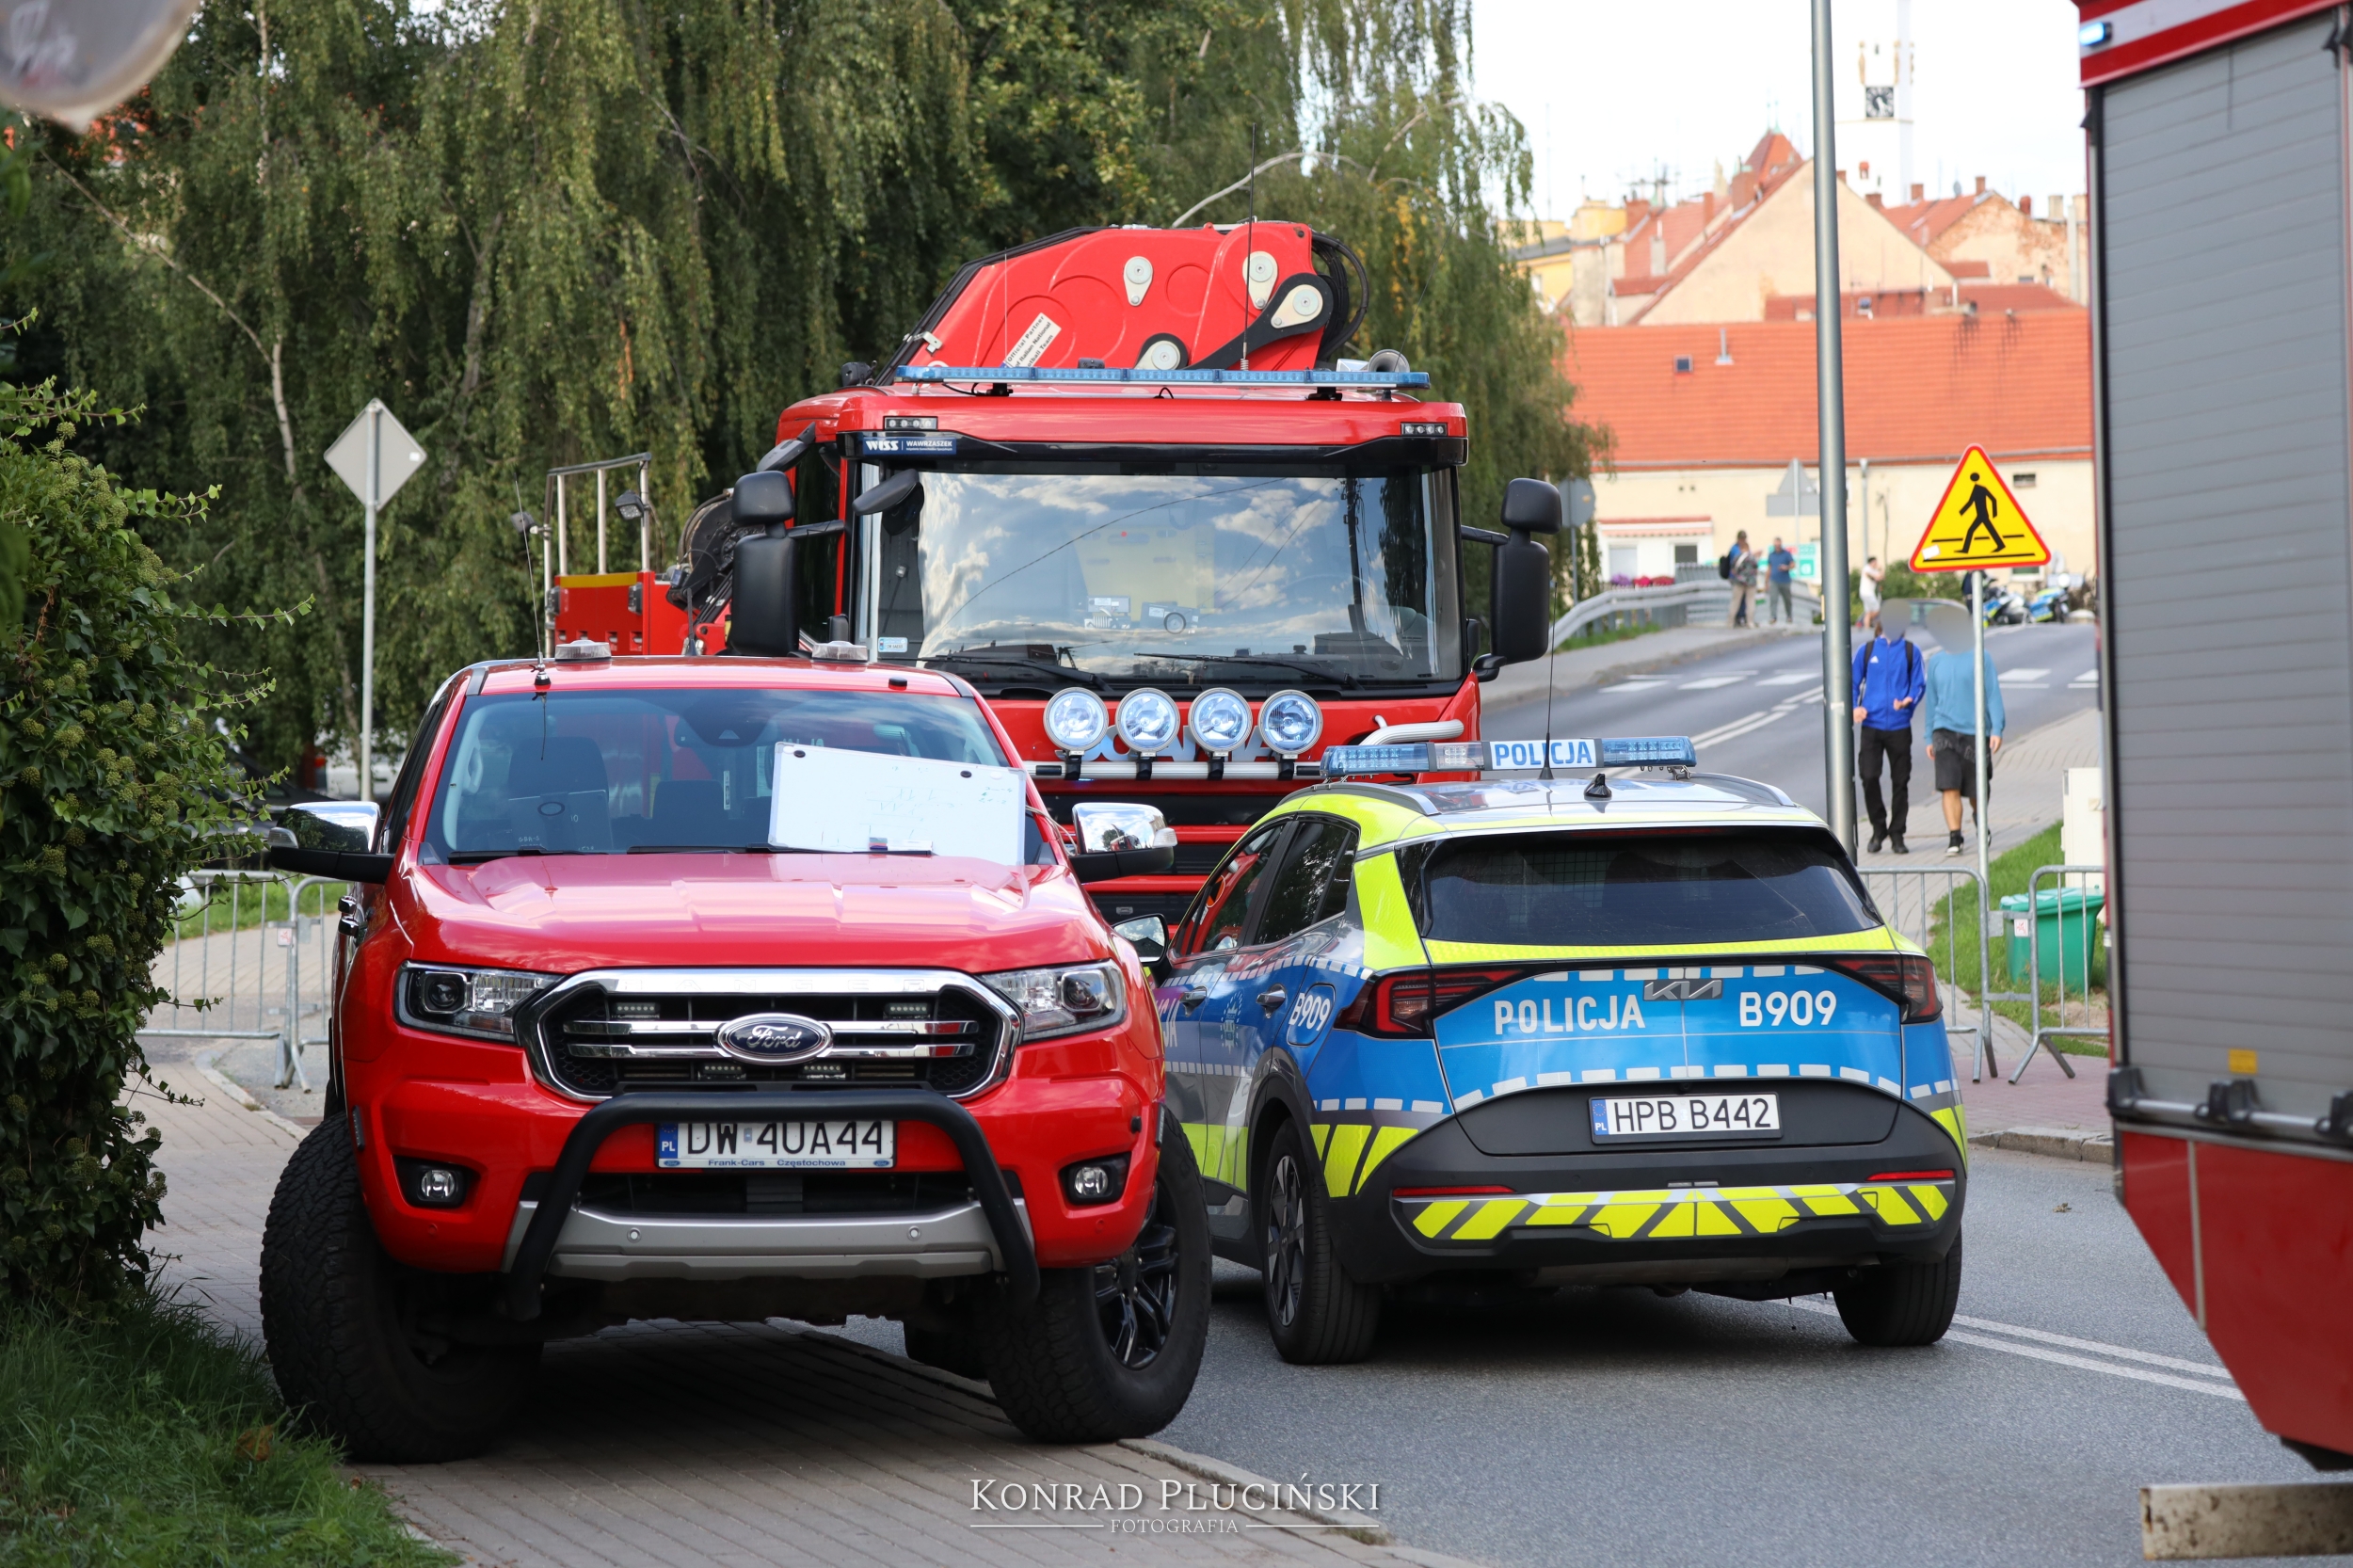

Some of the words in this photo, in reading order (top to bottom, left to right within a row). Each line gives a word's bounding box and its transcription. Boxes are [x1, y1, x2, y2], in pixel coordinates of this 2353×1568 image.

[1007, 339, 1026, 362] Official
[1025, 315, 1045, 340] Partner
[1019, 344, 1033, 361] Italian
[1032, 321, 1051, 344] National
[1027, 350, 1041, 367] otball
[1039, 334, 1053, 349] Team
[865, 440, 899, 451] WISS
[1494, 741, 1593, 766] POLICJA
[620, 979, 925, 991] RANGER
[1644, 980, 1722, 1000] KIA
[1289, 993, 1332, 1032] B909
[1494, 994, 1645, 1035] POLICJA
[1739, 990, 1837, 1027] B909
[747, 1024, 802, 1049] Ford
[1595, 1122, 1608, 1131] PL
[1614, 1100, 1676, 1132] HPB
[1689, 1097, 1771, 1129] B442
[662, 1142, 676, 1152] PL
[687, 1122, 738, 1155] DW
[757, 1121, 882, 1155] 4UA44
[776, 1159, 846, 1168] Częstochowa
